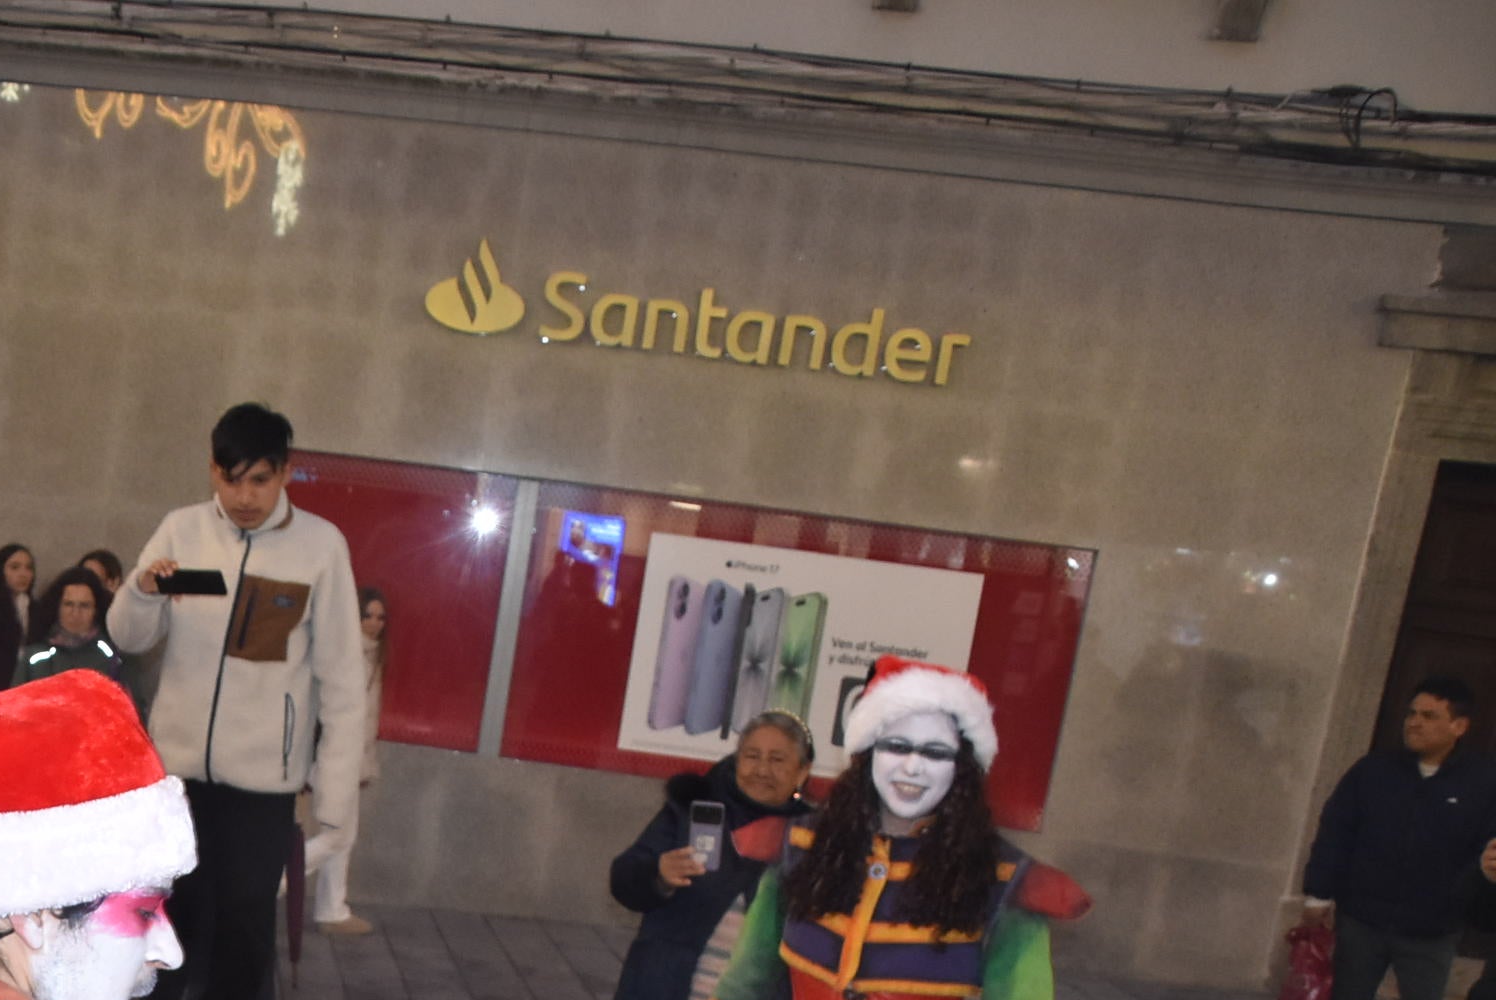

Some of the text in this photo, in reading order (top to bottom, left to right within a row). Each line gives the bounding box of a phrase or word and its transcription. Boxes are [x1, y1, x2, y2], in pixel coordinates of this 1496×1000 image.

[538, 270, 971, 386] Santander
[831, 636, 928, 659] Ven al Santander
